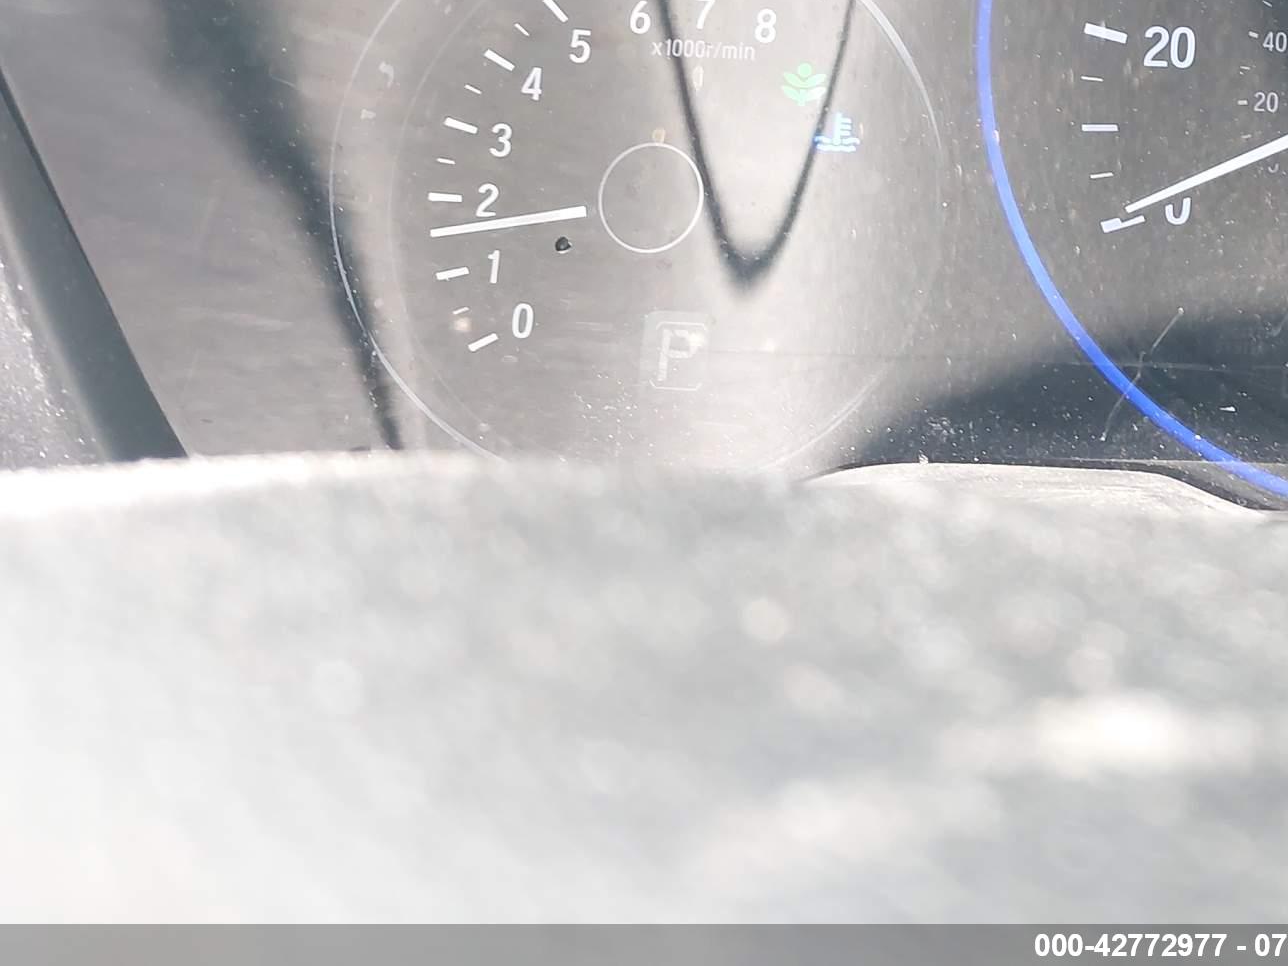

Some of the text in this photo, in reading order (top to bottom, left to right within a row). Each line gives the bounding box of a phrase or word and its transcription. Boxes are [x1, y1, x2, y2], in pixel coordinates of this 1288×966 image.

[629, 0, 651, 35] 6
[754, 8, 777, 44] 8
[569, 29, 592, 64] 5
[1143, 25, 1196, 69] 20
[1262, 31, 1287, 53] 40
[521, 67, 543, 101] 4
[1253, 91, 1279, 113] 20
[488, 123, 512, 158] 3
[475, 183, 499, 218] 2
[487, 249, 500, 284] 1
[511, 303, 534, 339] 0
[656, 328, 703, 383] P
